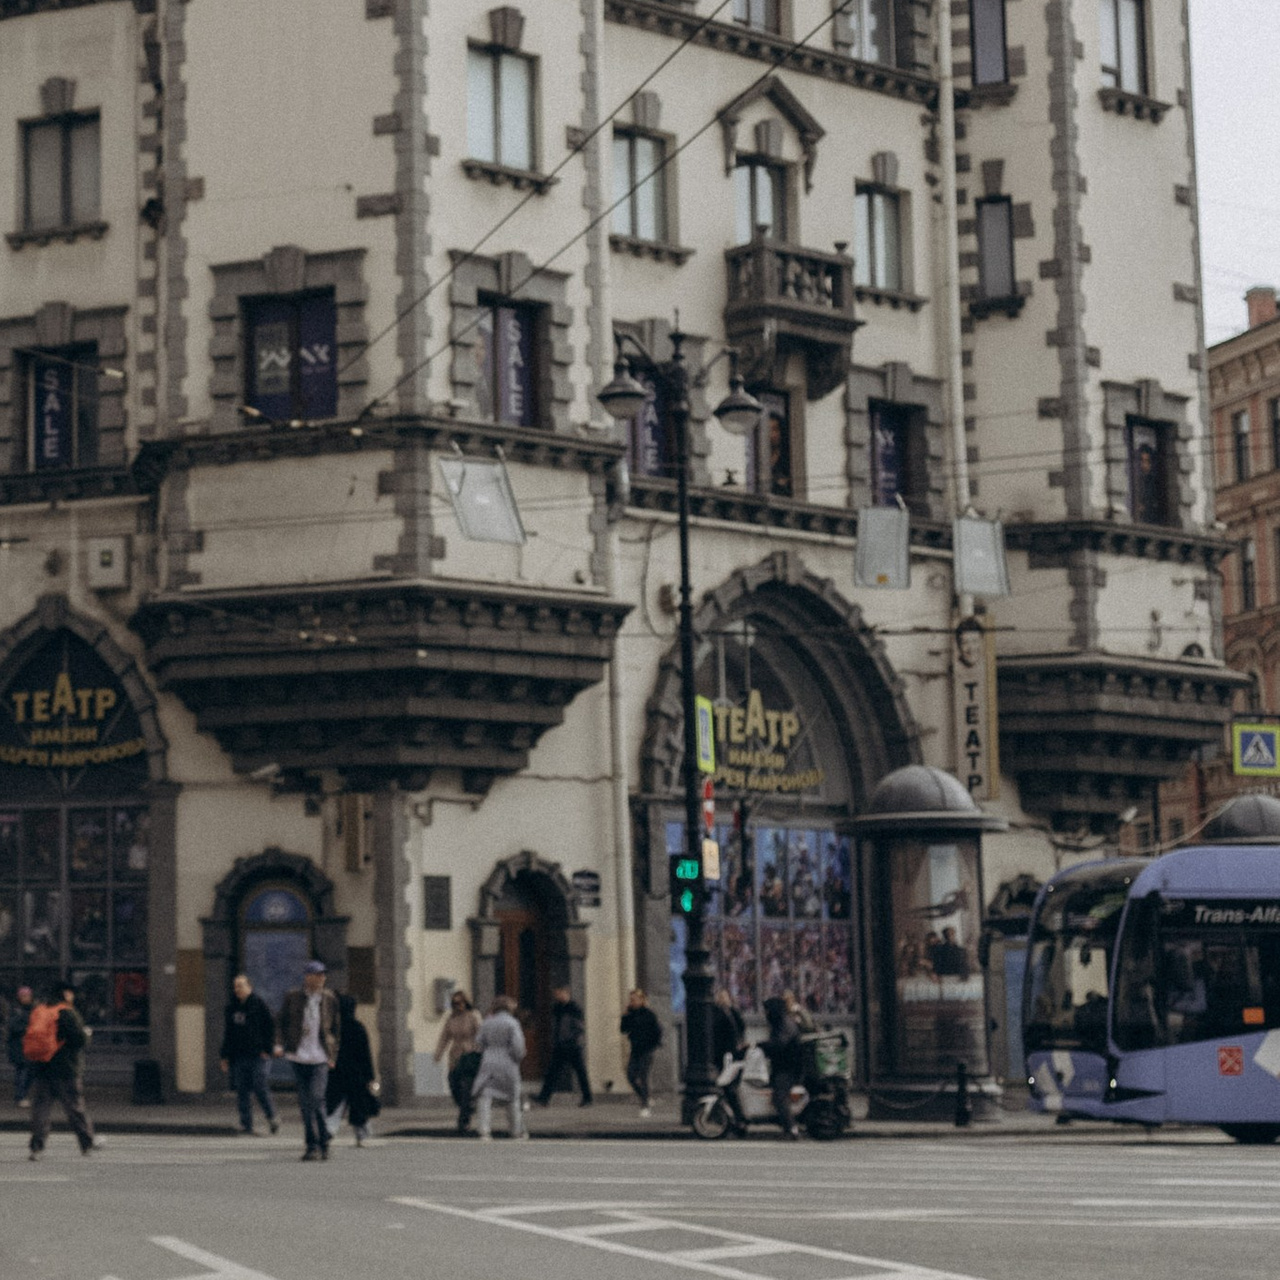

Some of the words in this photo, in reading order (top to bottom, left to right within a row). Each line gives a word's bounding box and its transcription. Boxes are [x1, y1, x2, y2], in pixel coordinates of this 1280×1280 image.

[507, 319, 524, 416] SALE
[44, 369, 60, 458] SALE
[11, 672, 117, 722] ТЕАТР
[714, 688, 800, 748] ТЕАТР
[964, 681, 983, 793] ТЕАТР
